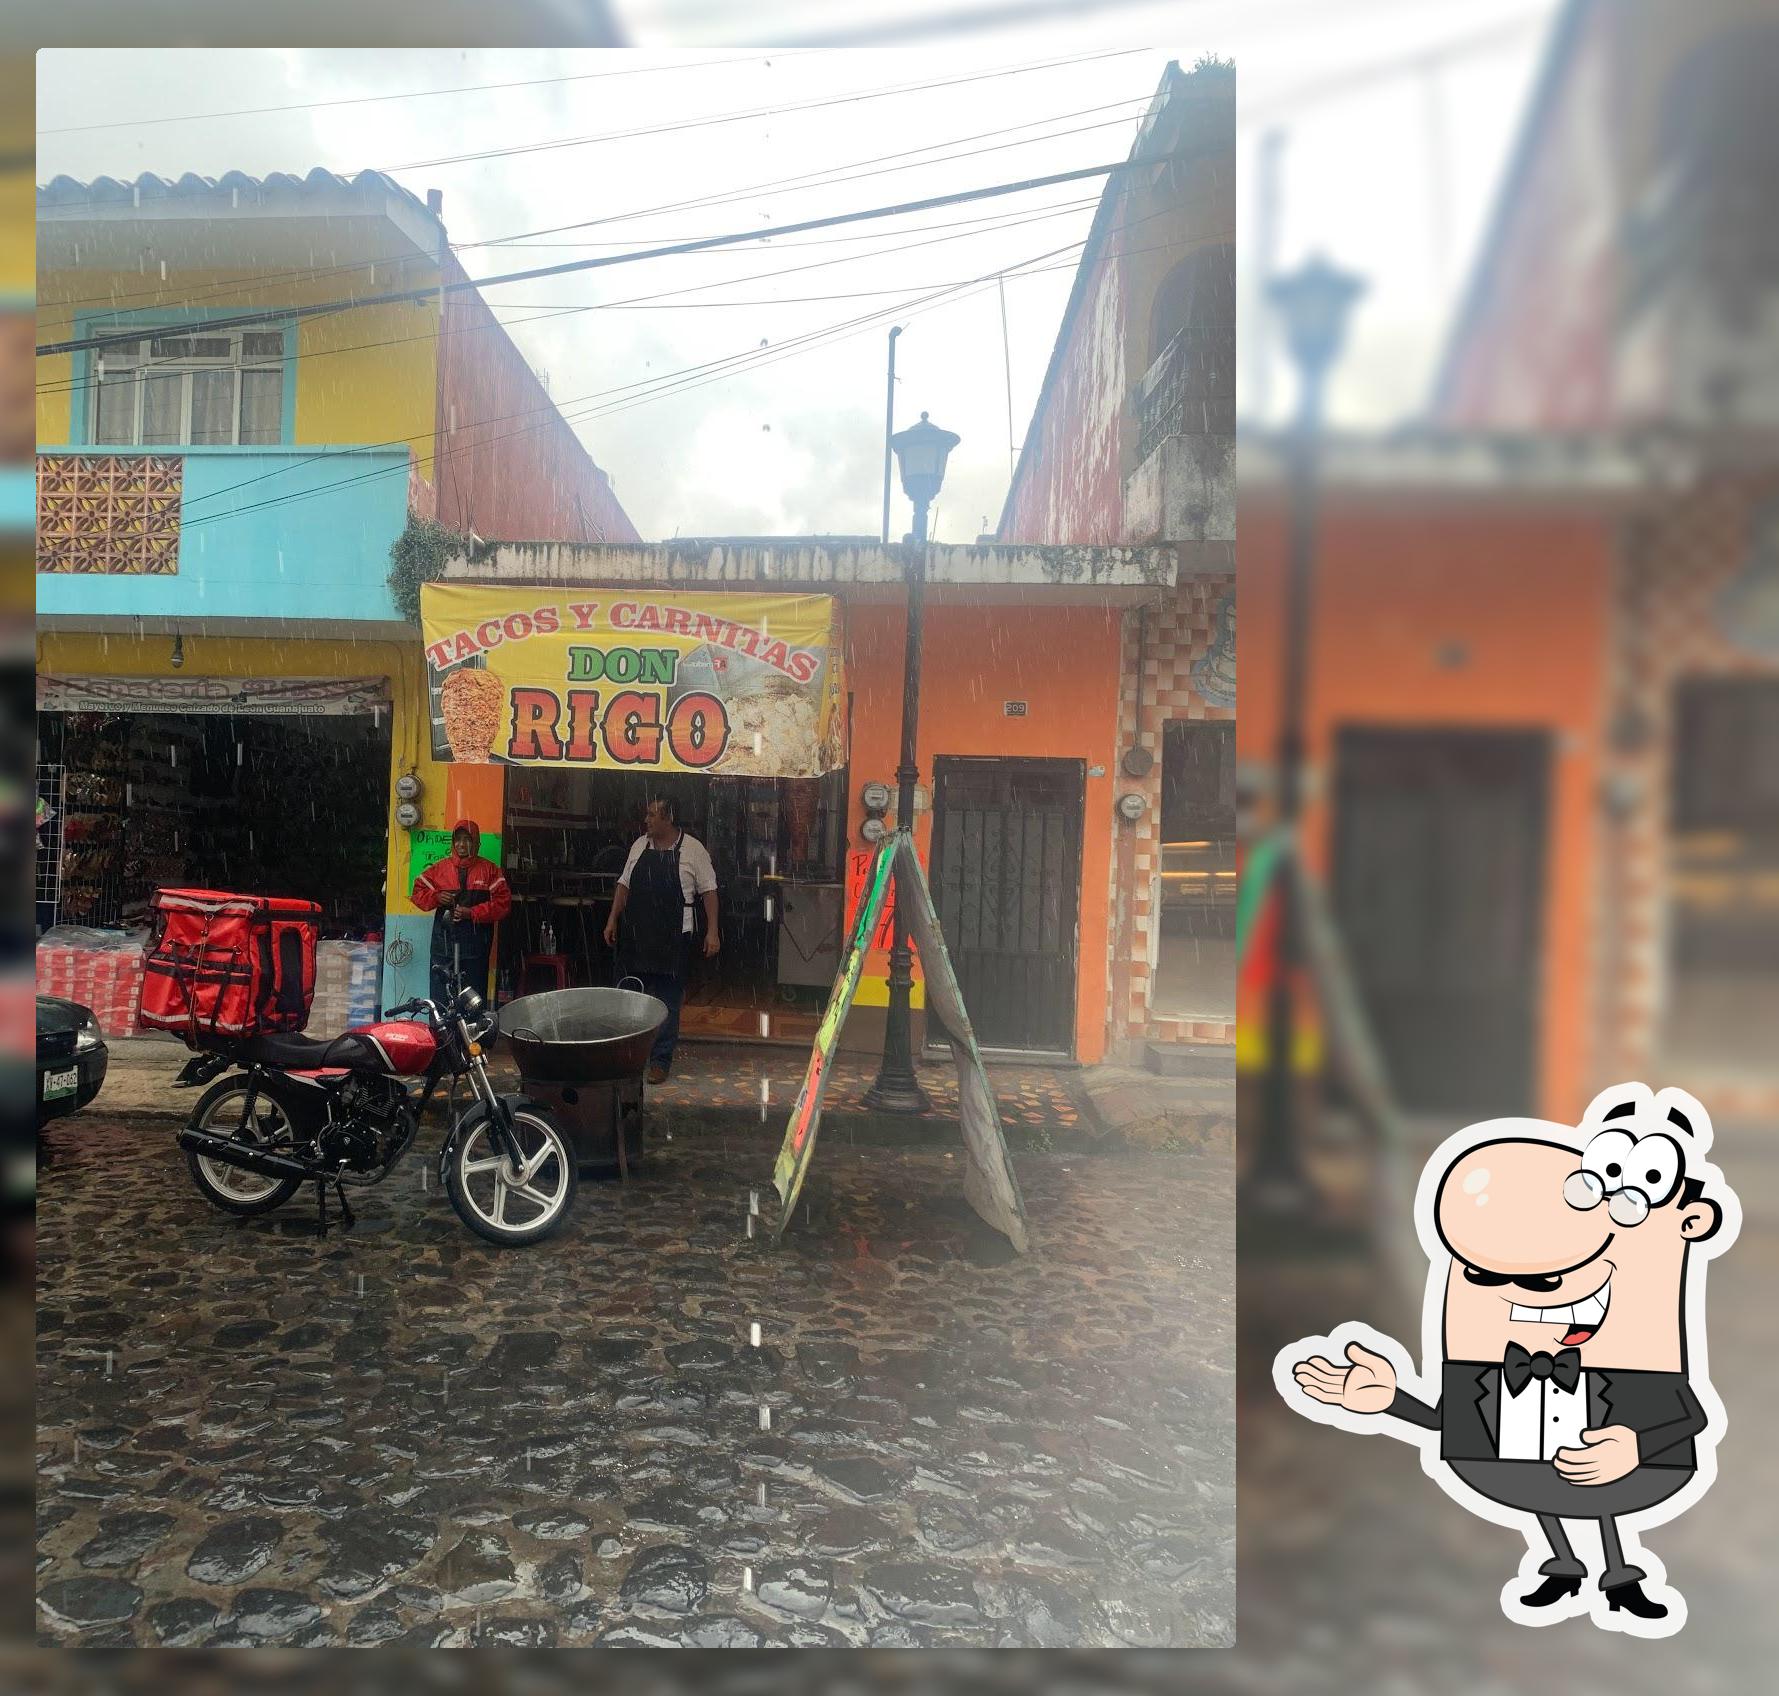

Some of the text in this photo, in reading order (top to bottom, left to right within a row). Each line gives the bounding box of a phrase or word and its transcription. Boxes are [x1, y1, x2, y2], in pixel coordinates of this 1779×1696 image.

[426, 607, 560, 669] TACOS
[569, 603, 598, 630] Y
[609, 603, 818, 681] CARNITAS
[567, 647, 679, 684] DON
[179, 703, 220, 713] Calzado
[222, 703, 235, 713] de
[265, 703, 325, 715] Guanajuato
[1006, 704, 1024, 713] 209
[508, 688, 731, 767] RIGO
